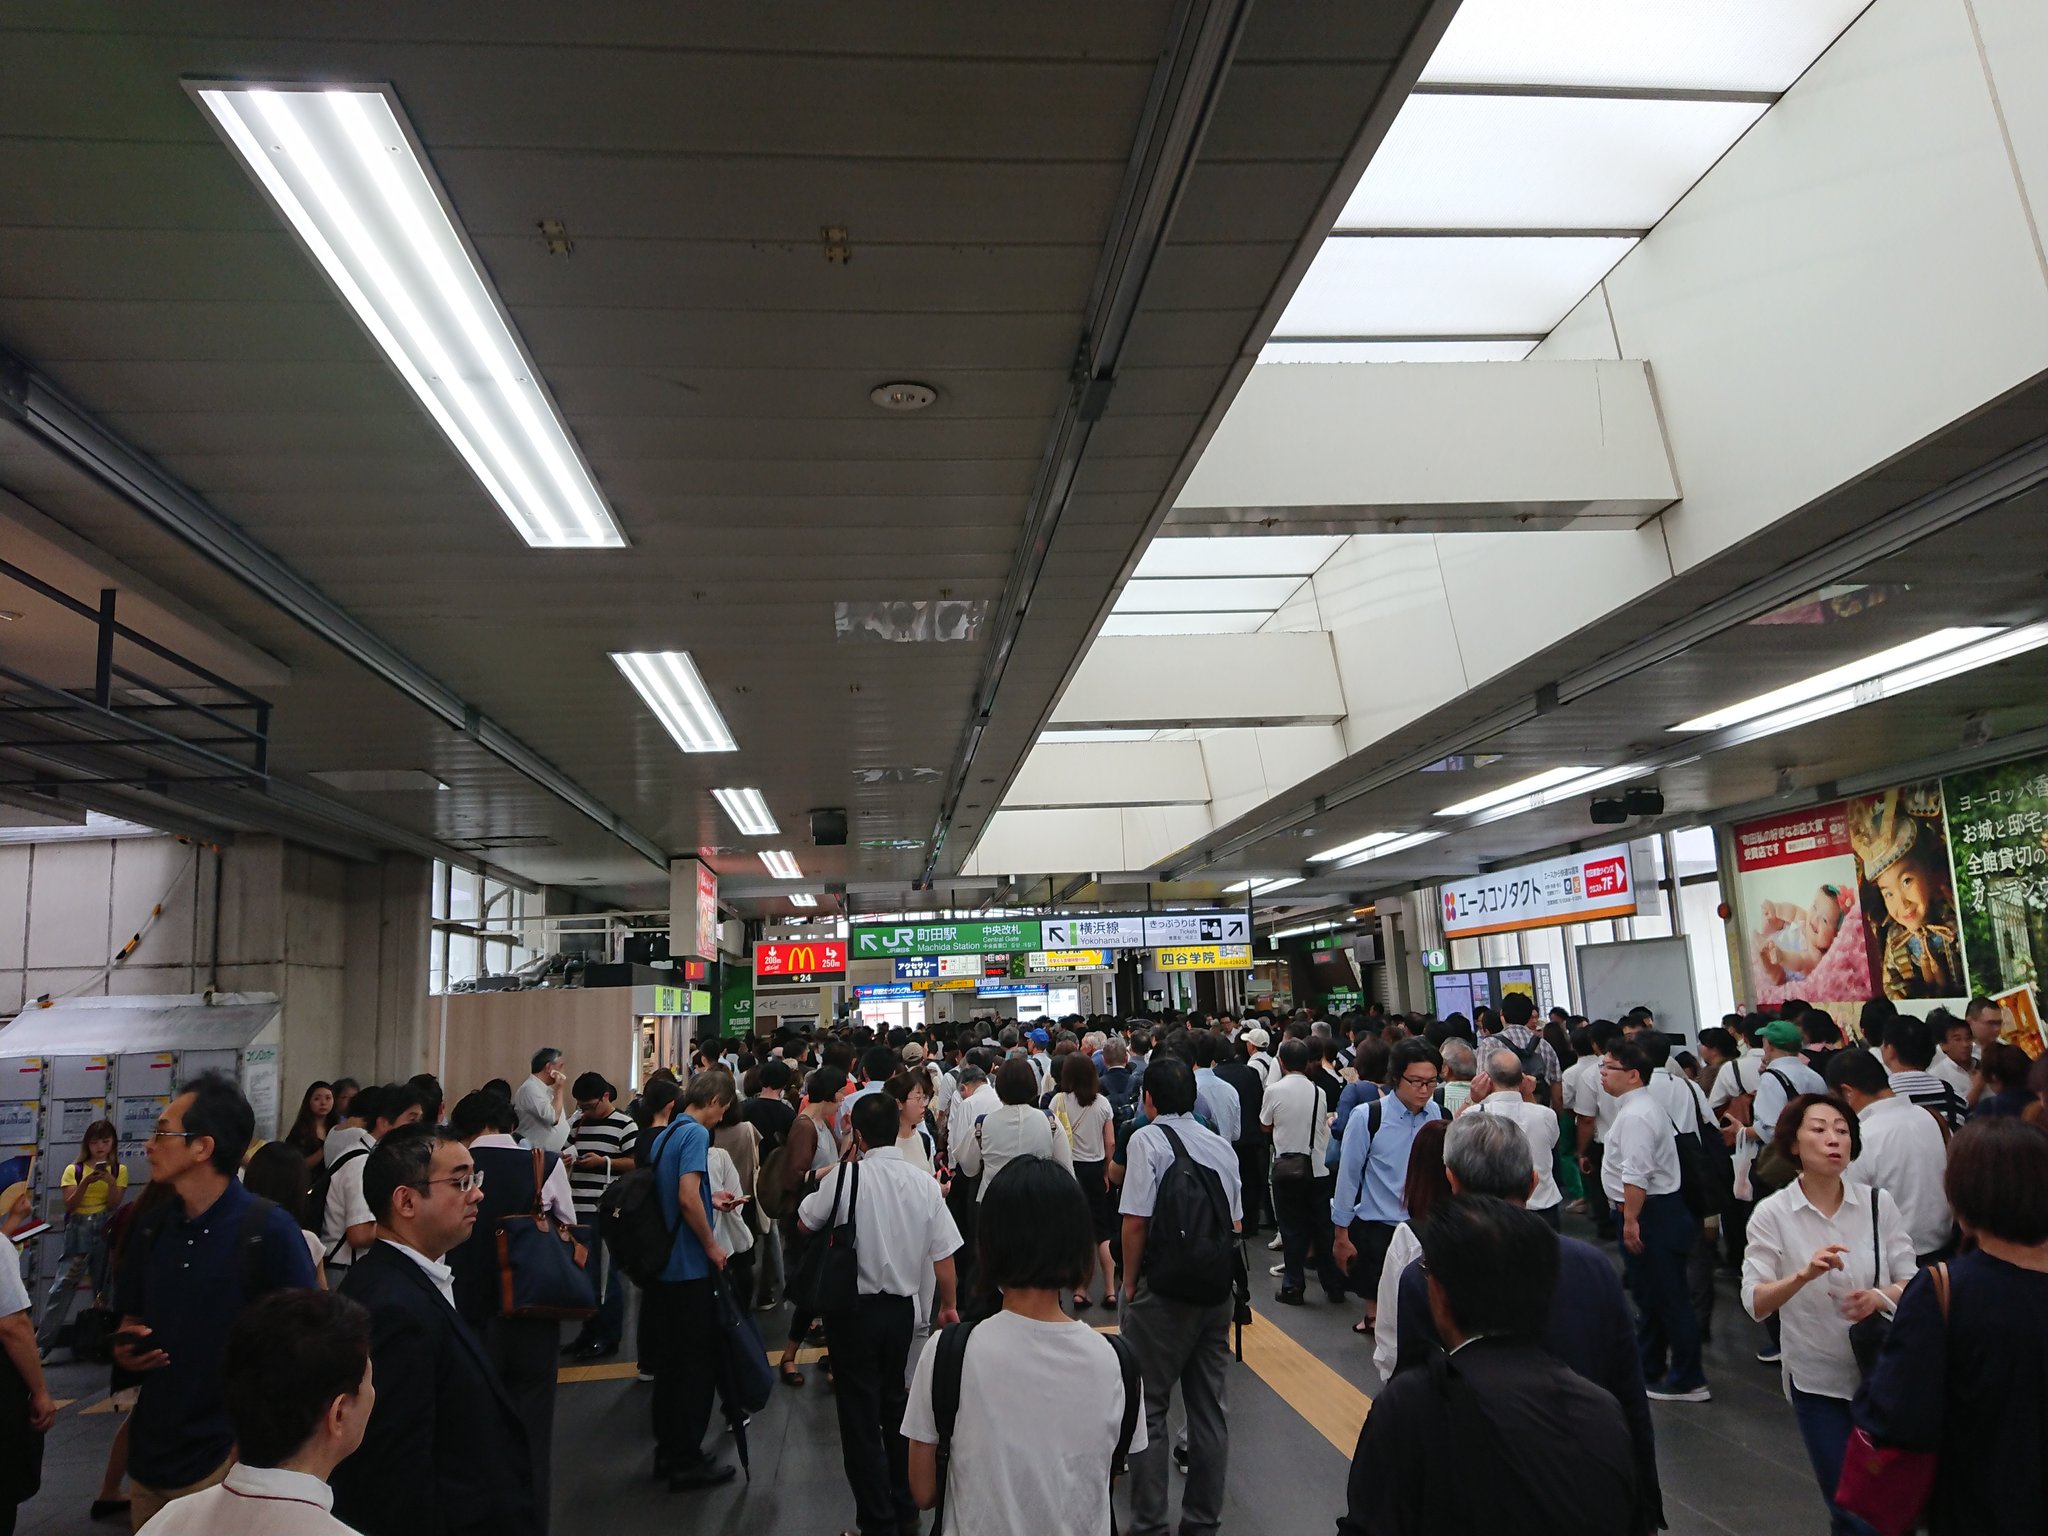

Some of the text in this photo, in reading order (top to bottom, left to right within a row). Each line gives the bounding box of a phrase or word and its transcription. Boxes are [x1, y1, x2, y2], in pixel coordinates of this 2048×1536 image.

[1966, 845, 2047, 876] 全館貸切の
[1601, 876, 1613, 891] 7F
[1458, 877, 1541, 917] エースコンタクト
[1079, 921, 1120, 935] 横浜線
[1149, 918, 1197, 929] きっぷうりば
[917, 928, 957, 941] 町田駅
[982, 924, 1022, 935] 中央改札
[882, 928, 914, 947] JR
[1004, 935, 1020, 943] Gate
[1079, 935, 1139, 945] Yokohama Line
[917, 942, 981, 952] Machida Station
[764, 956, 782, 965] 200m
[822, 959, 840, 968] 250m
[1161, 951, 1216, 966] 四谷学院
[897, 962, 937, 971] アクセサリー
[800, 973, 812, 983] 24
[1541, 967, 1553, 1015] 町田駅総合
